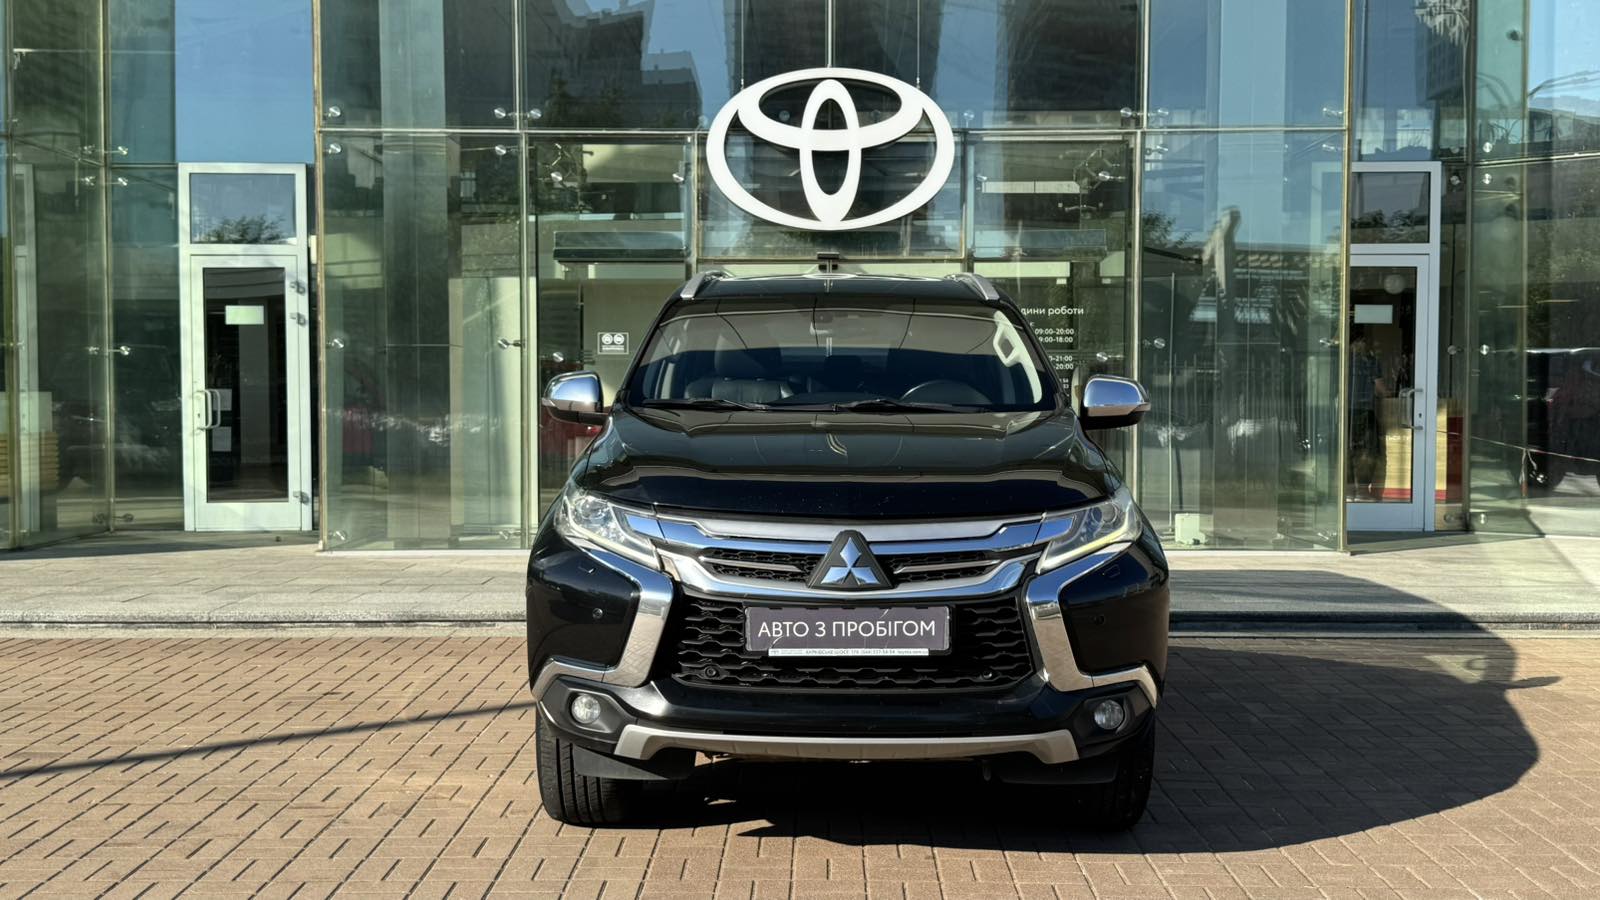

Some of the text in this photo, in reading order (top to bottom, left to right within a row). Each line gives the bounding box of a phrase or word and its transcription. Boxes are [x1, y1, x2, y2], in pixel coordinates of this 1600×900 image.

[1048, 305, 1084, 317] роботи
[758, 621, 809, 638] АВТО
[832, 620, 935, 637] ПРОБІГОМ
